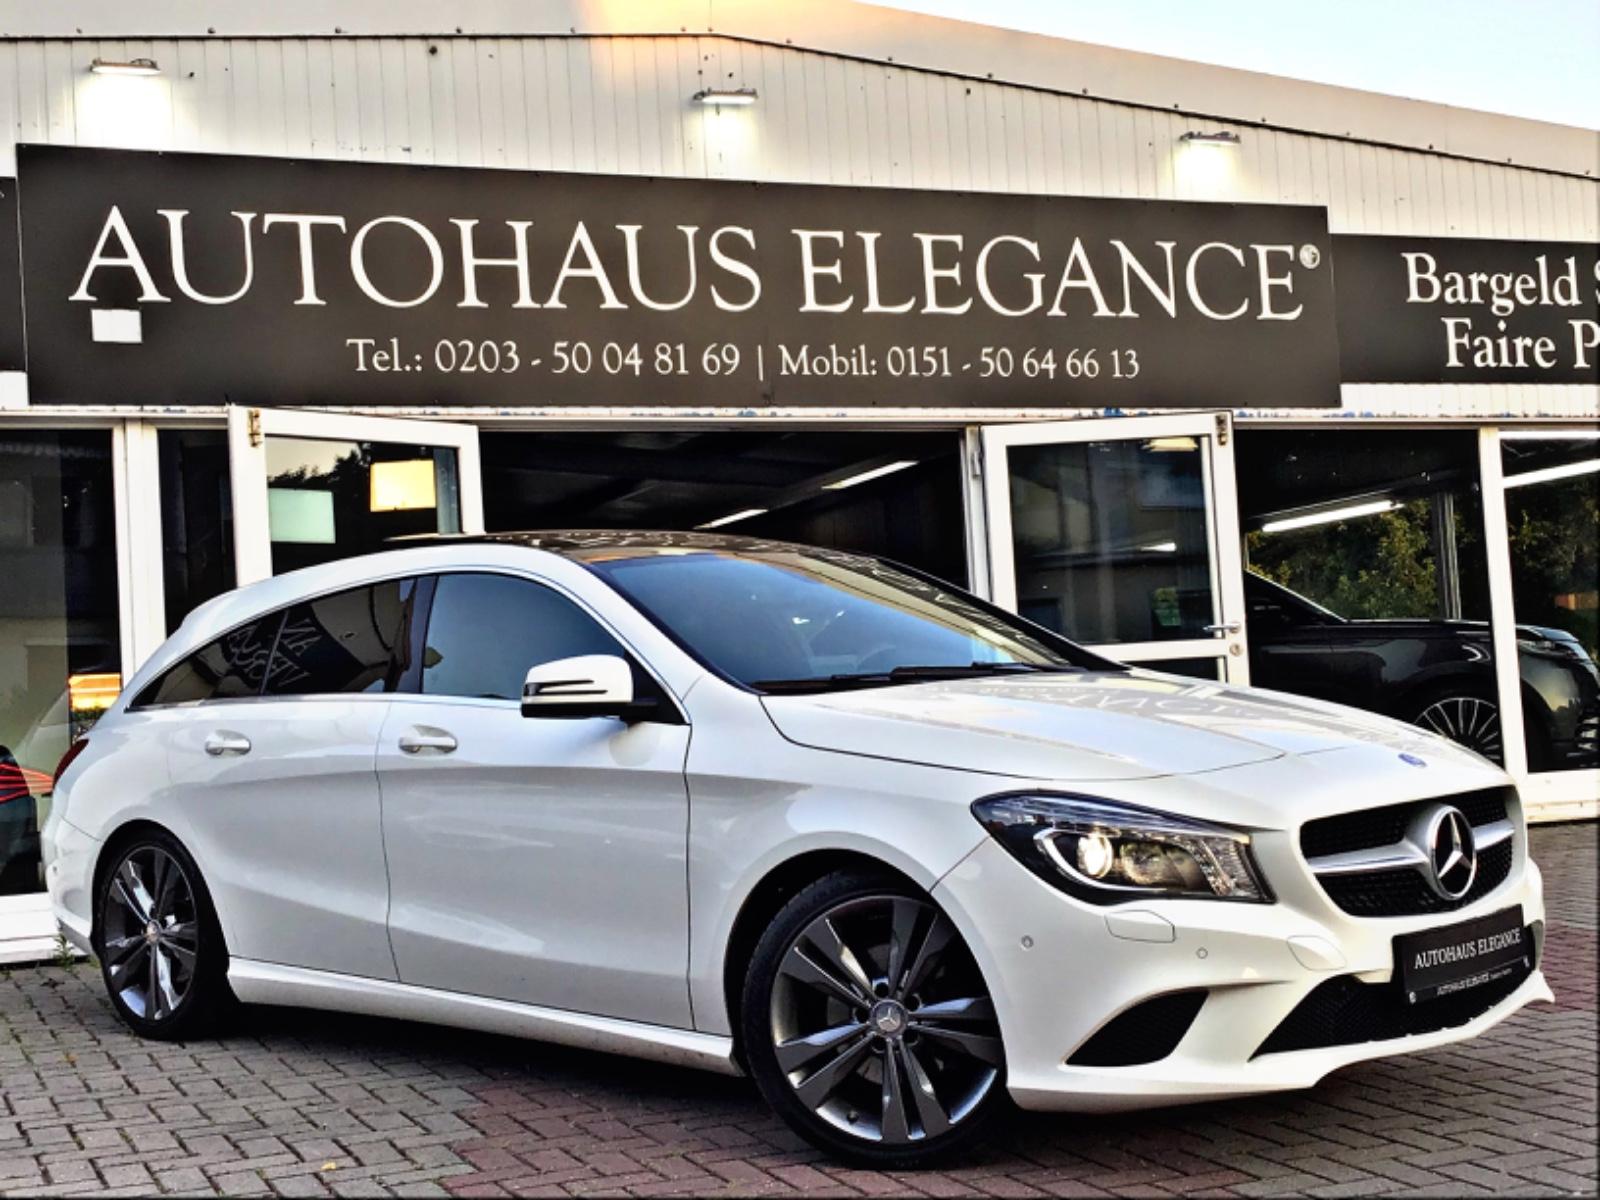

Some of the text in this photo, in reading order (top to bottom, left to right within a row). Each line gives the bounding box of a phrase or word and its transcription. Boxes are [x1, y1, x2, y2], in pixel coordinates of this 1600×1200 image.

[69, 205, 1304, 321] AUTOHAUS ELEGANCE
[1401, 252, 1582, 316] Bargeld
[346, 337, 422, 373] Tel.:
[435, 338, 520, 374] 0203
[553, 340, 592, 374] 50
[603, 341, 644, 376] 04
[655, 343, 689, 376] 81
[702, 342, 741, 376] 69
[778, 343, 878, 377] Mobil:
[886, 345, 952, 378] 0151
[980, 346, 1014, 379] 50
[1023, 347, 1057, 380] 64
[1066, 348, 1100, 379] 66
[1111, 348, 1140, 379] 13
[1441, 317, 1558, 369] Faire
[1414, 927, 1521, 970] AUTOHAUS ELEGANCE
